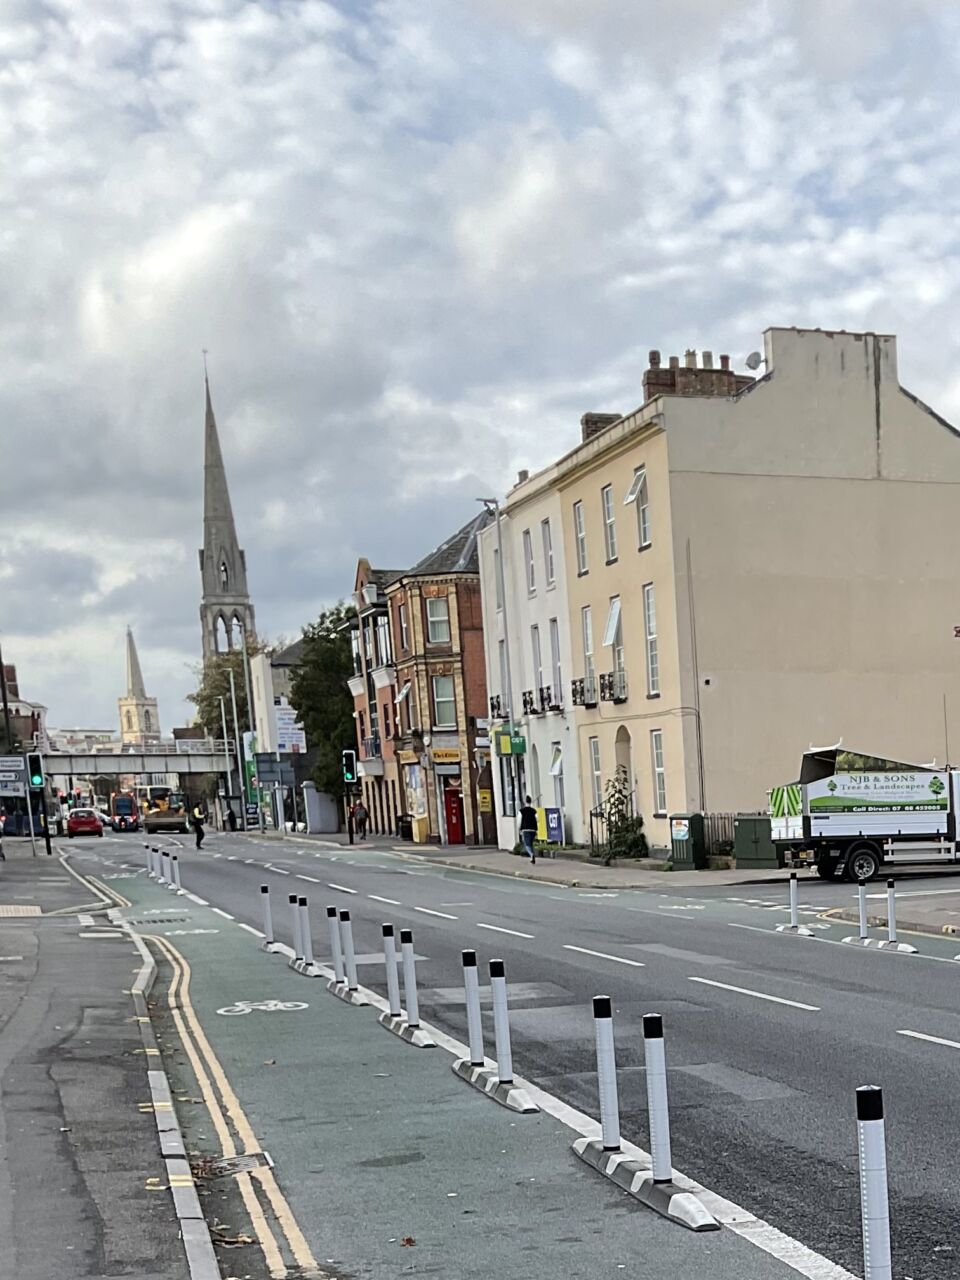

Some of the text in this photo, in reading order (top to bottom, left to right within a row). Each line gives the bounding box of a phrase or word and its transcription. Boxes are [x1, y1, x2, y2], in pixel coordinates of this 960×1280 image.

[849, 775, 870, 784] NJB
[884, 775, 915, 783] SONS
[873, 783, 925, 791] Landscapes
